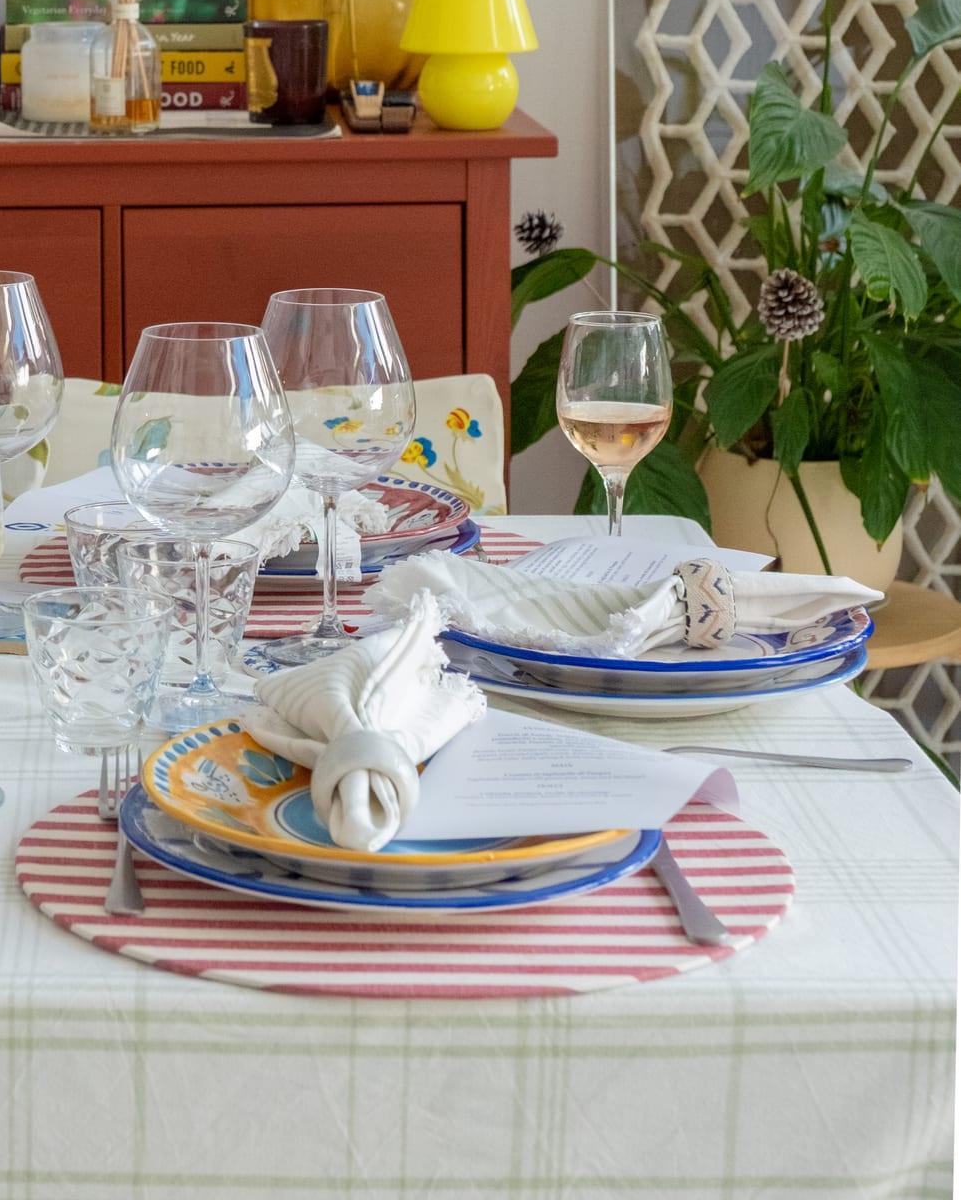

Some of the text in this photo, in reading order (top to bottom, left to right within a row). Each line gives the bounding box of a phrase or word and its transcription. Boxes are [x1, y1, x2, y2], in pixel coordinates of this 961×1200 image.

[22, 4, 67, 16] Vegetarian
[170, 60, 205, 75] FOOD
[160, 92, 203, 107] OOD
